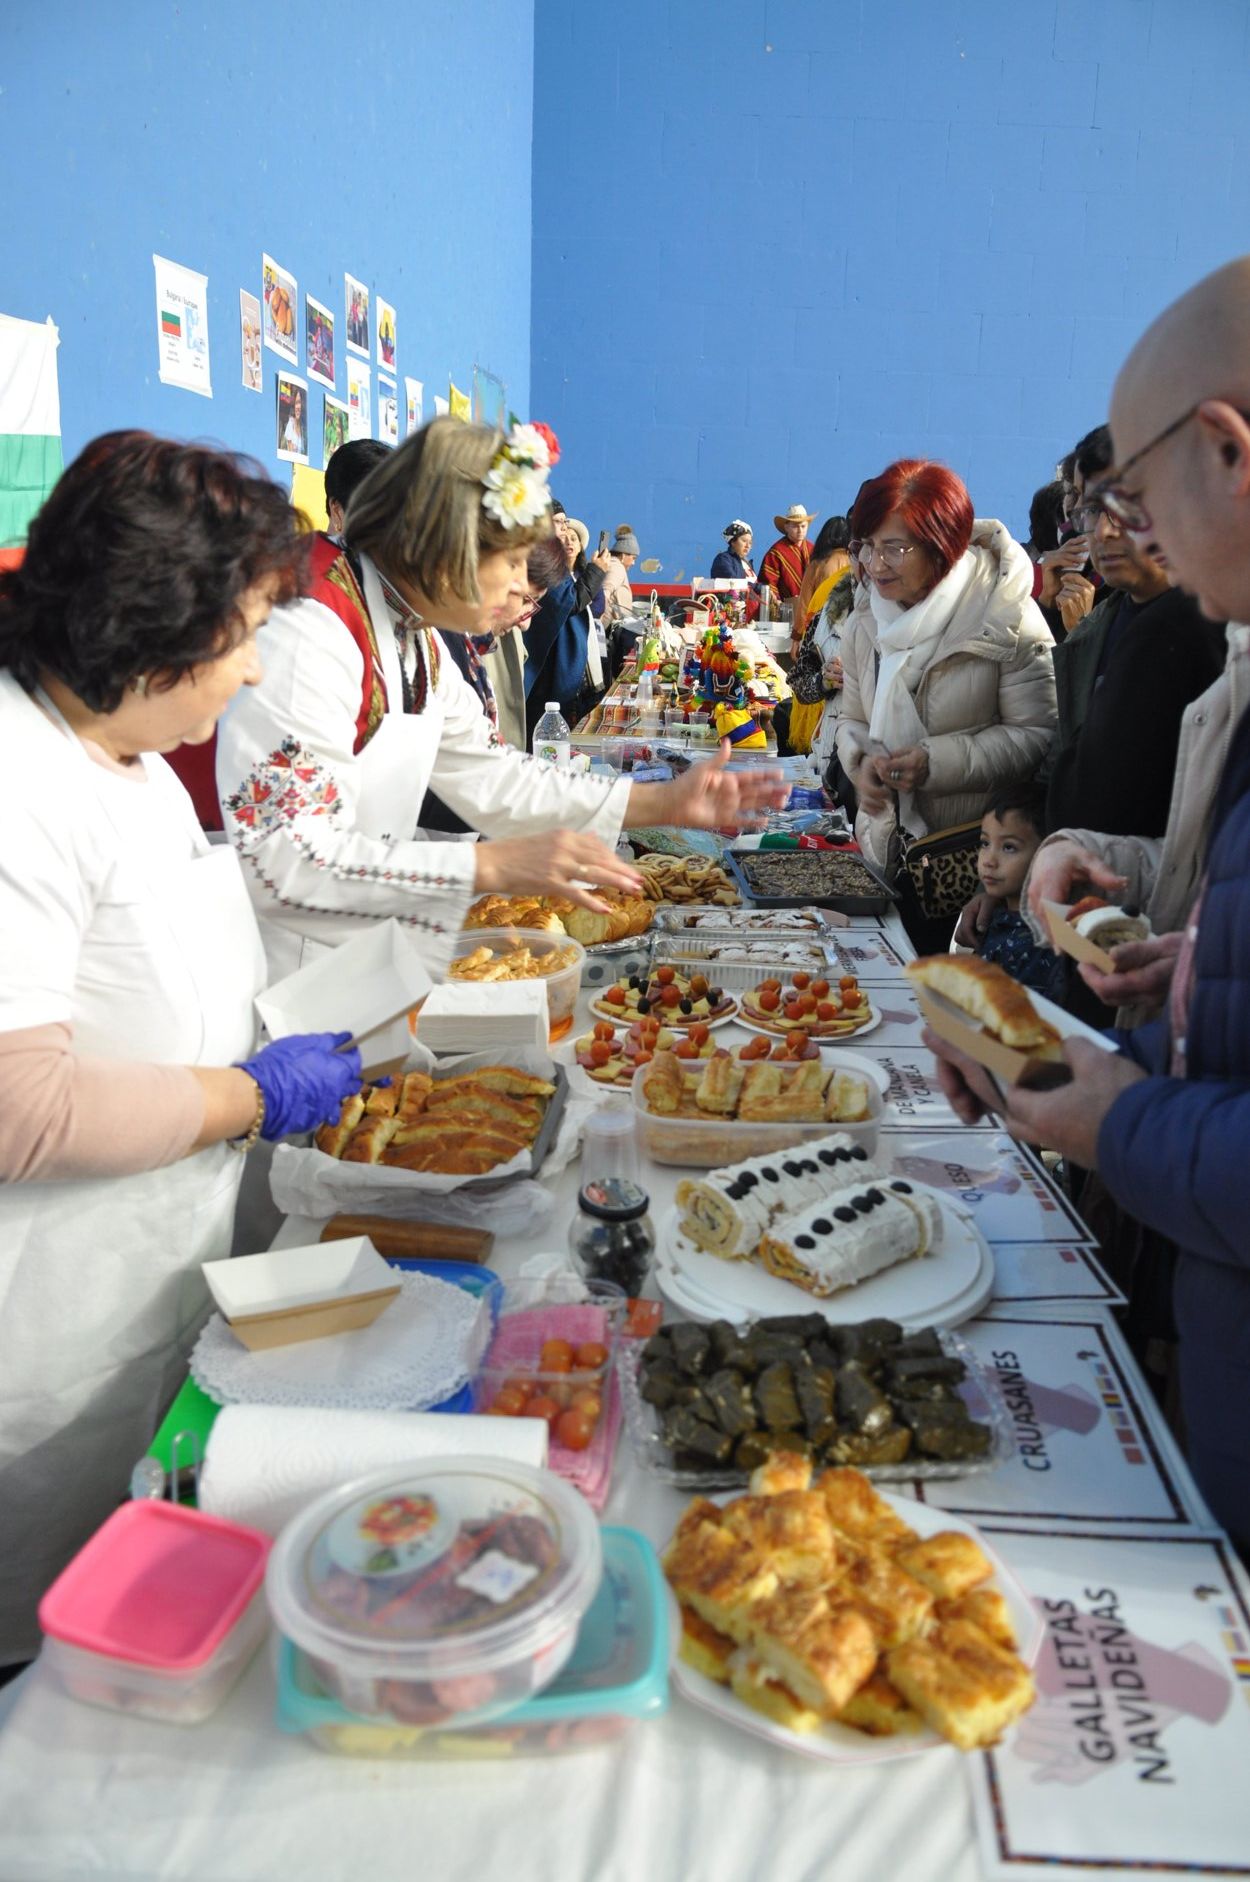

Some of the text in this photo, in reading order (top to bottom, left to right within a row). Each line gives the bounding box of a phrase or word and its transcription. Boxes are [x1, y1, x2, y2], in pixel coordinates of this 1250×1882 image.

[895, 1102, 916, 1116] DE
[901, 1064, 931, 1097] CANELA
[992, 1349, 1052, 1473] CRUASANES
[1043, 1598, 1116, 1765] GALLETAS
[1084, 1587, 1176, 1785] NAVIDEÑAS
